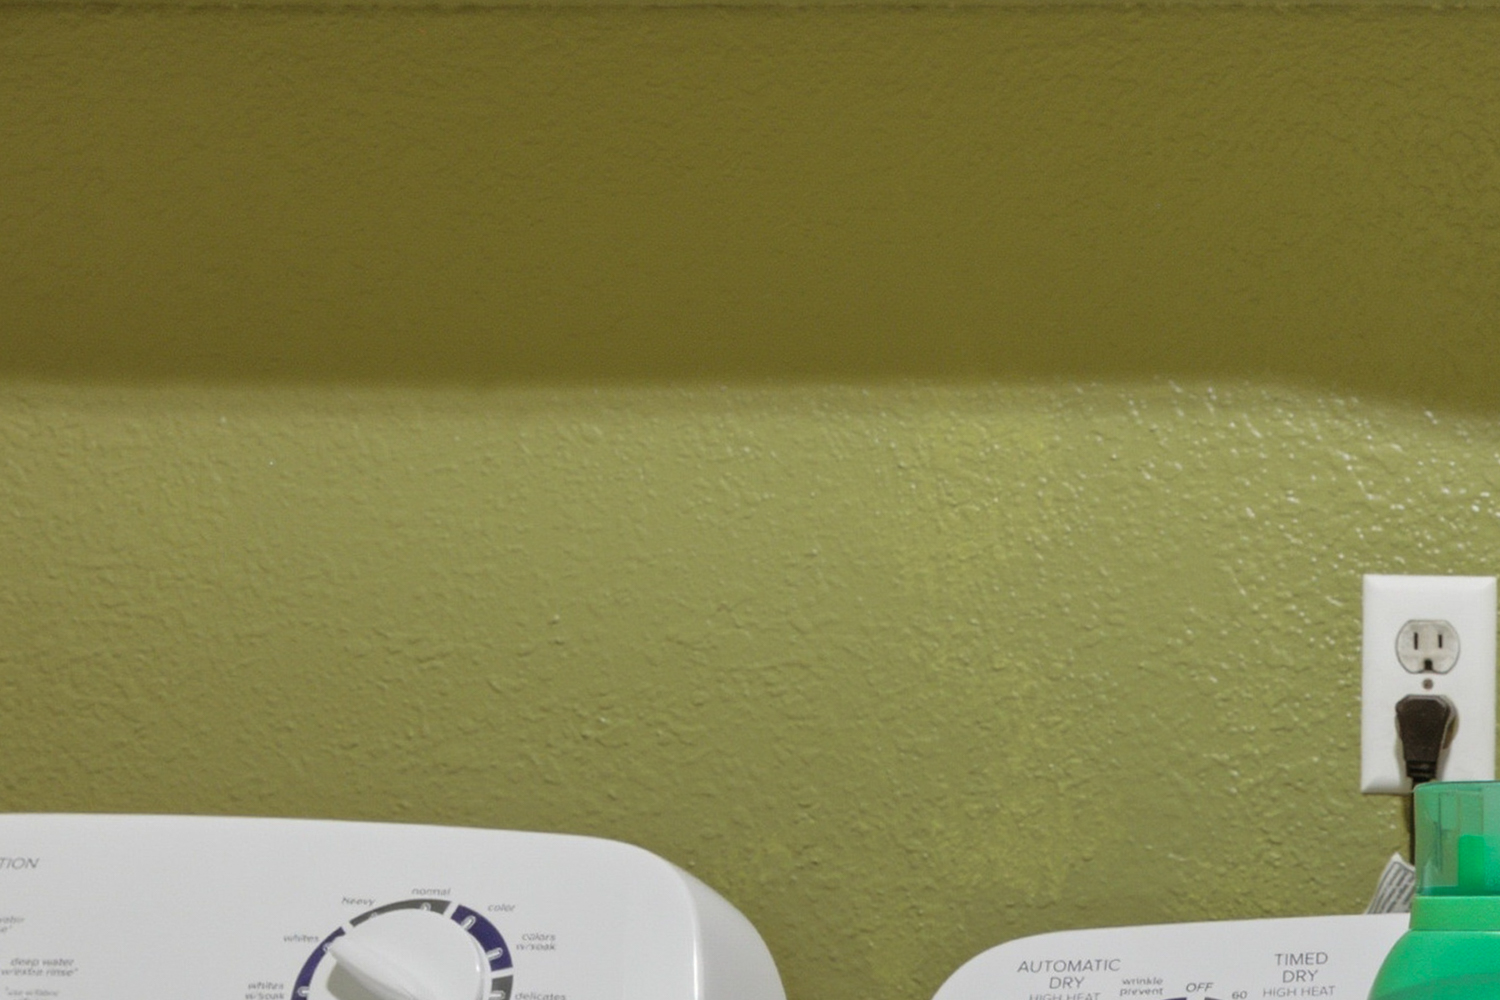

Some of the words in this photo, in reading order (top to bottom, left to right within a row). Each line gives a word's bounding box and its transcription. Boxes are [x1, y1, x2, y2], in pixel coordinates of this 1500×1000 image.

[411, 887, 451, 897] normal
[487, 902, 516, 913] color
[283, 933, 320, 943] whites
[521, 932, 556, 942] colors
[1274, 952, 1329, 967] TIMED
[1017, 958, 1121, 973] AUTOMATIC
[1281, 968, 1318, 983] DRY
[1048, 975, 1085, 990] DRY
[1121, 977, 1164, 987] wrinkle
[1185, 982, 1213, 993] OFF
[1119, 987, 1164, 998] prevent
[1231, 990, 1248, 1000] 60
[1262, 987, 1297, 998] HIGH
[1300, 985, 1336, 997] HEAT
